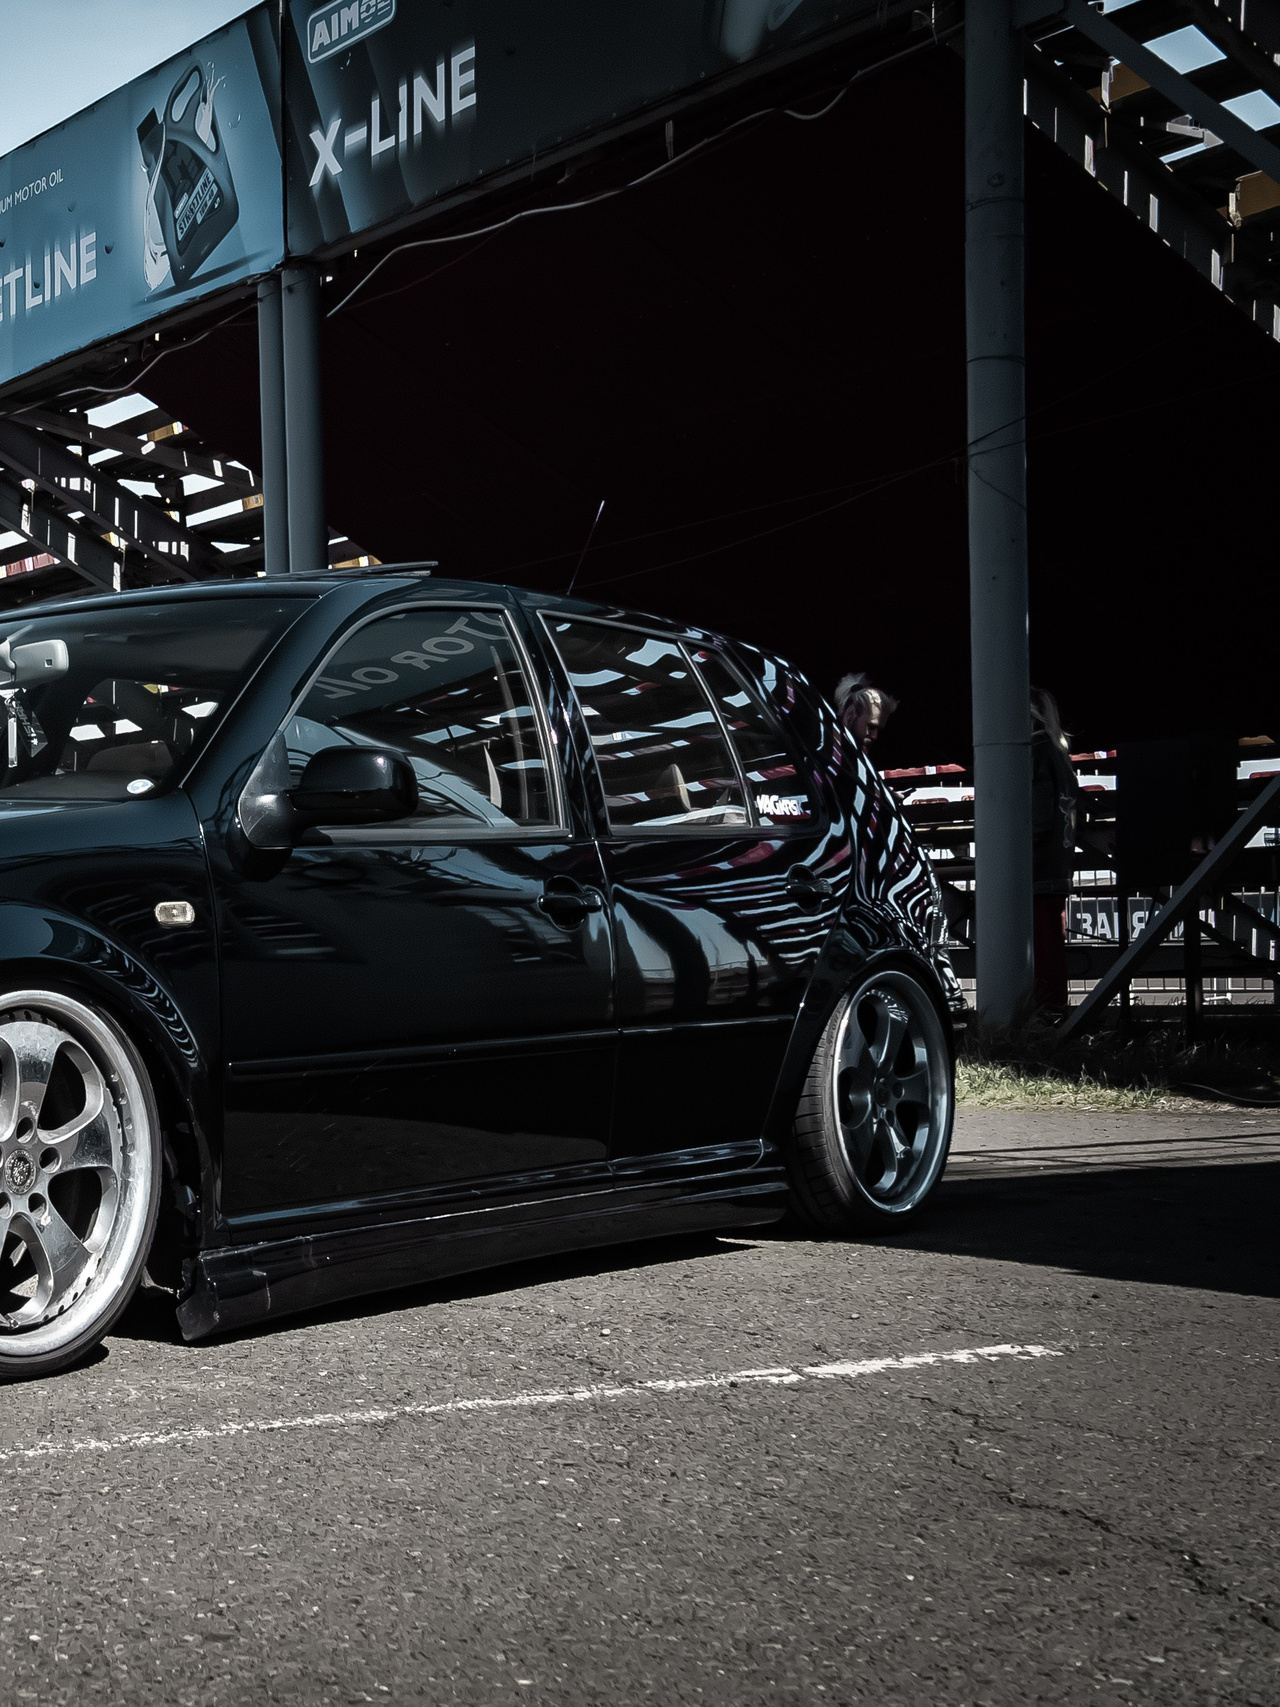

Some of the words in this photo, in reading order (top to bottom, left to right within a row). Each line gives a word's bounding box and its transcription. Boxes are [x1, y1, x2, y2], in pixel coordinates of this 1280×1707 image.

[309, 46, 476, 187] X-LINE
[14, 176, 48, 206] MOTOR
[48, 168, 64, 187] OIL
